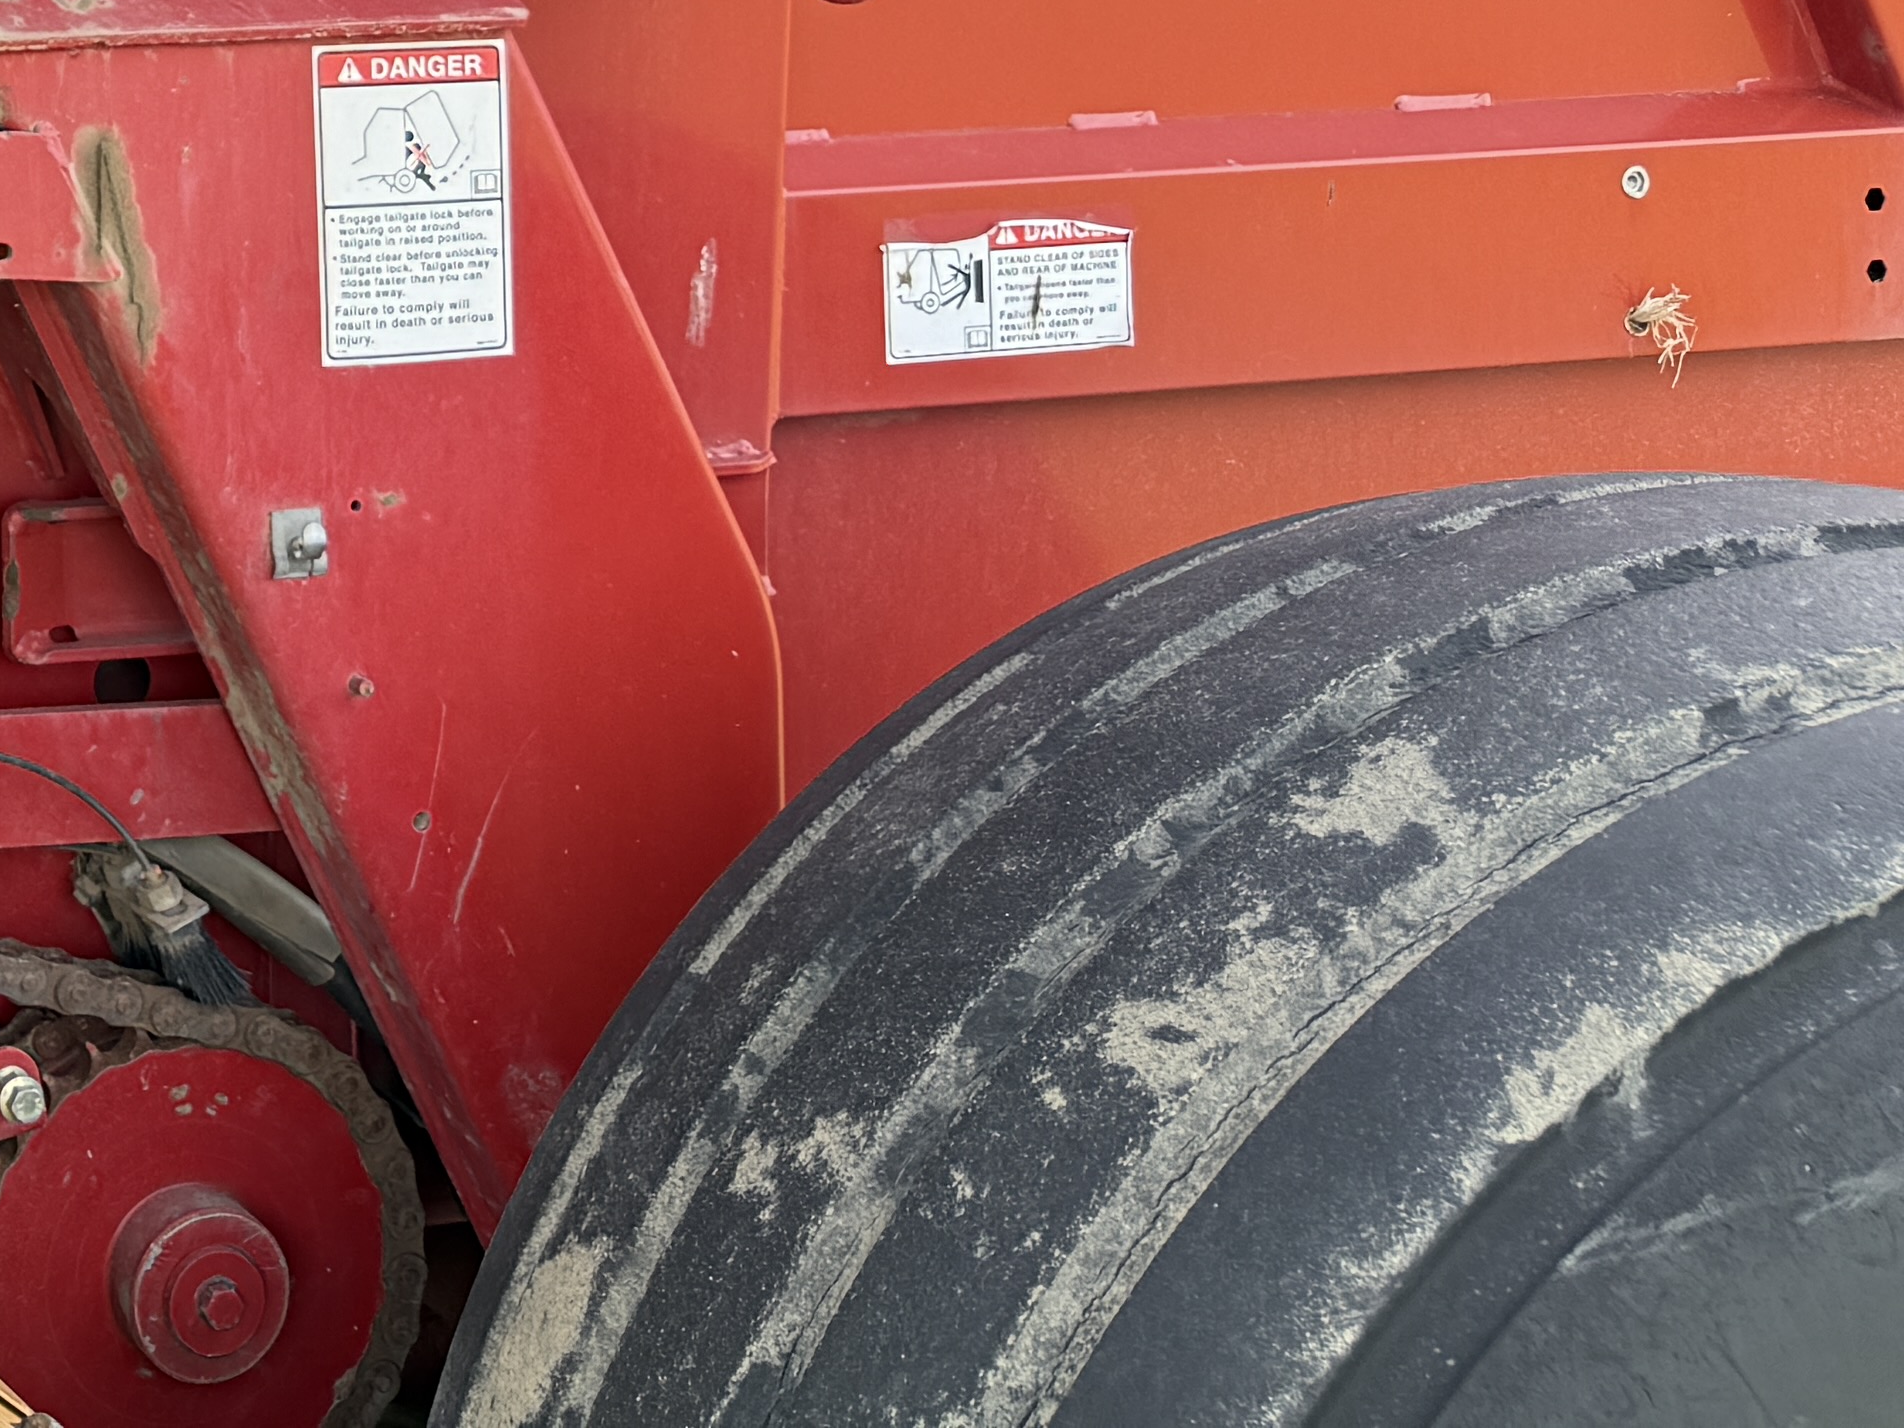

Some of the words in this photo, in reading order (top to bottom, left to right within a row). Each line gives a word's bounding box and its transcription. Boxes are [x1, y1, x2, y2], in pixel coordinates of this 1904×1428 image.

[370, 54, 482, 81] DANGER
[339, 214, 381, 225] Engage
[384, 212, 427, 224] tailgate
[430, 210, 453, 219] lock
[457, 209, 493, 218] before
[339, 226, 384, 236] working
[388, 226, 401, 234] on
[421, 221, 460, 231] around
[1024, 222, 1111, 242] DANG
[339, 237, 381, 249] tailgate
[385, 236, 396, 245] in
[399, 235, 433, 244] raised
[438, 232, 487, 245] position.
[340, 253, 372, 264] Stand
[375, 252, 402, 262] clear
[406, 250, 442, 260] before
[445, 247, 498, 257] unlocking
[997, 255, 1030, 265] STAND
[1034, 251, 1068, 262] CLEAR
[1071, 250, 1084, 259] OF
[1089, 248, 1119, 259] SIDES
[340, 266, 382, 277] tailgate
[386, 264, 413, 273] lock.
[421, 261, 464, 272] Tailgate
[467, 260, 490, 270] may
[997, 267, 1019, 276] AND
[1022, 265, 1050, 275] REAR
[1054, 263, 1066, 273] OF
[1071, 261, 1117, 271] MACHINE
[340, 278, 371, 287] close
[374, 276, 406, 286] faster
[410, 275, 435, 284] than
[439, 274, 459, 284] you
[463, 272, 483, 281] can
[341, 291, 371, 299] move
[375, 289, 406, 300] away.
[335, 305, 378, 317] Failure
[383, 304, 394, 314] to
[399, 300, 444, 314] comply
[449, 298, 470, 310] will
[999, 310, 1036, 320] Failur
[1056, 305, 1094, 315] comply
[335, 319, 371, 331] result
[376, 319, 387, 329] in
[392, 317, 426, 328] death
[431, 316, 443, 326] or
[448, 313, 494, 324] serious
[1048, 318, 1079, 328] death
[1083, 318, 1093, 326] or
[335, 334, 374, 348] injury.
